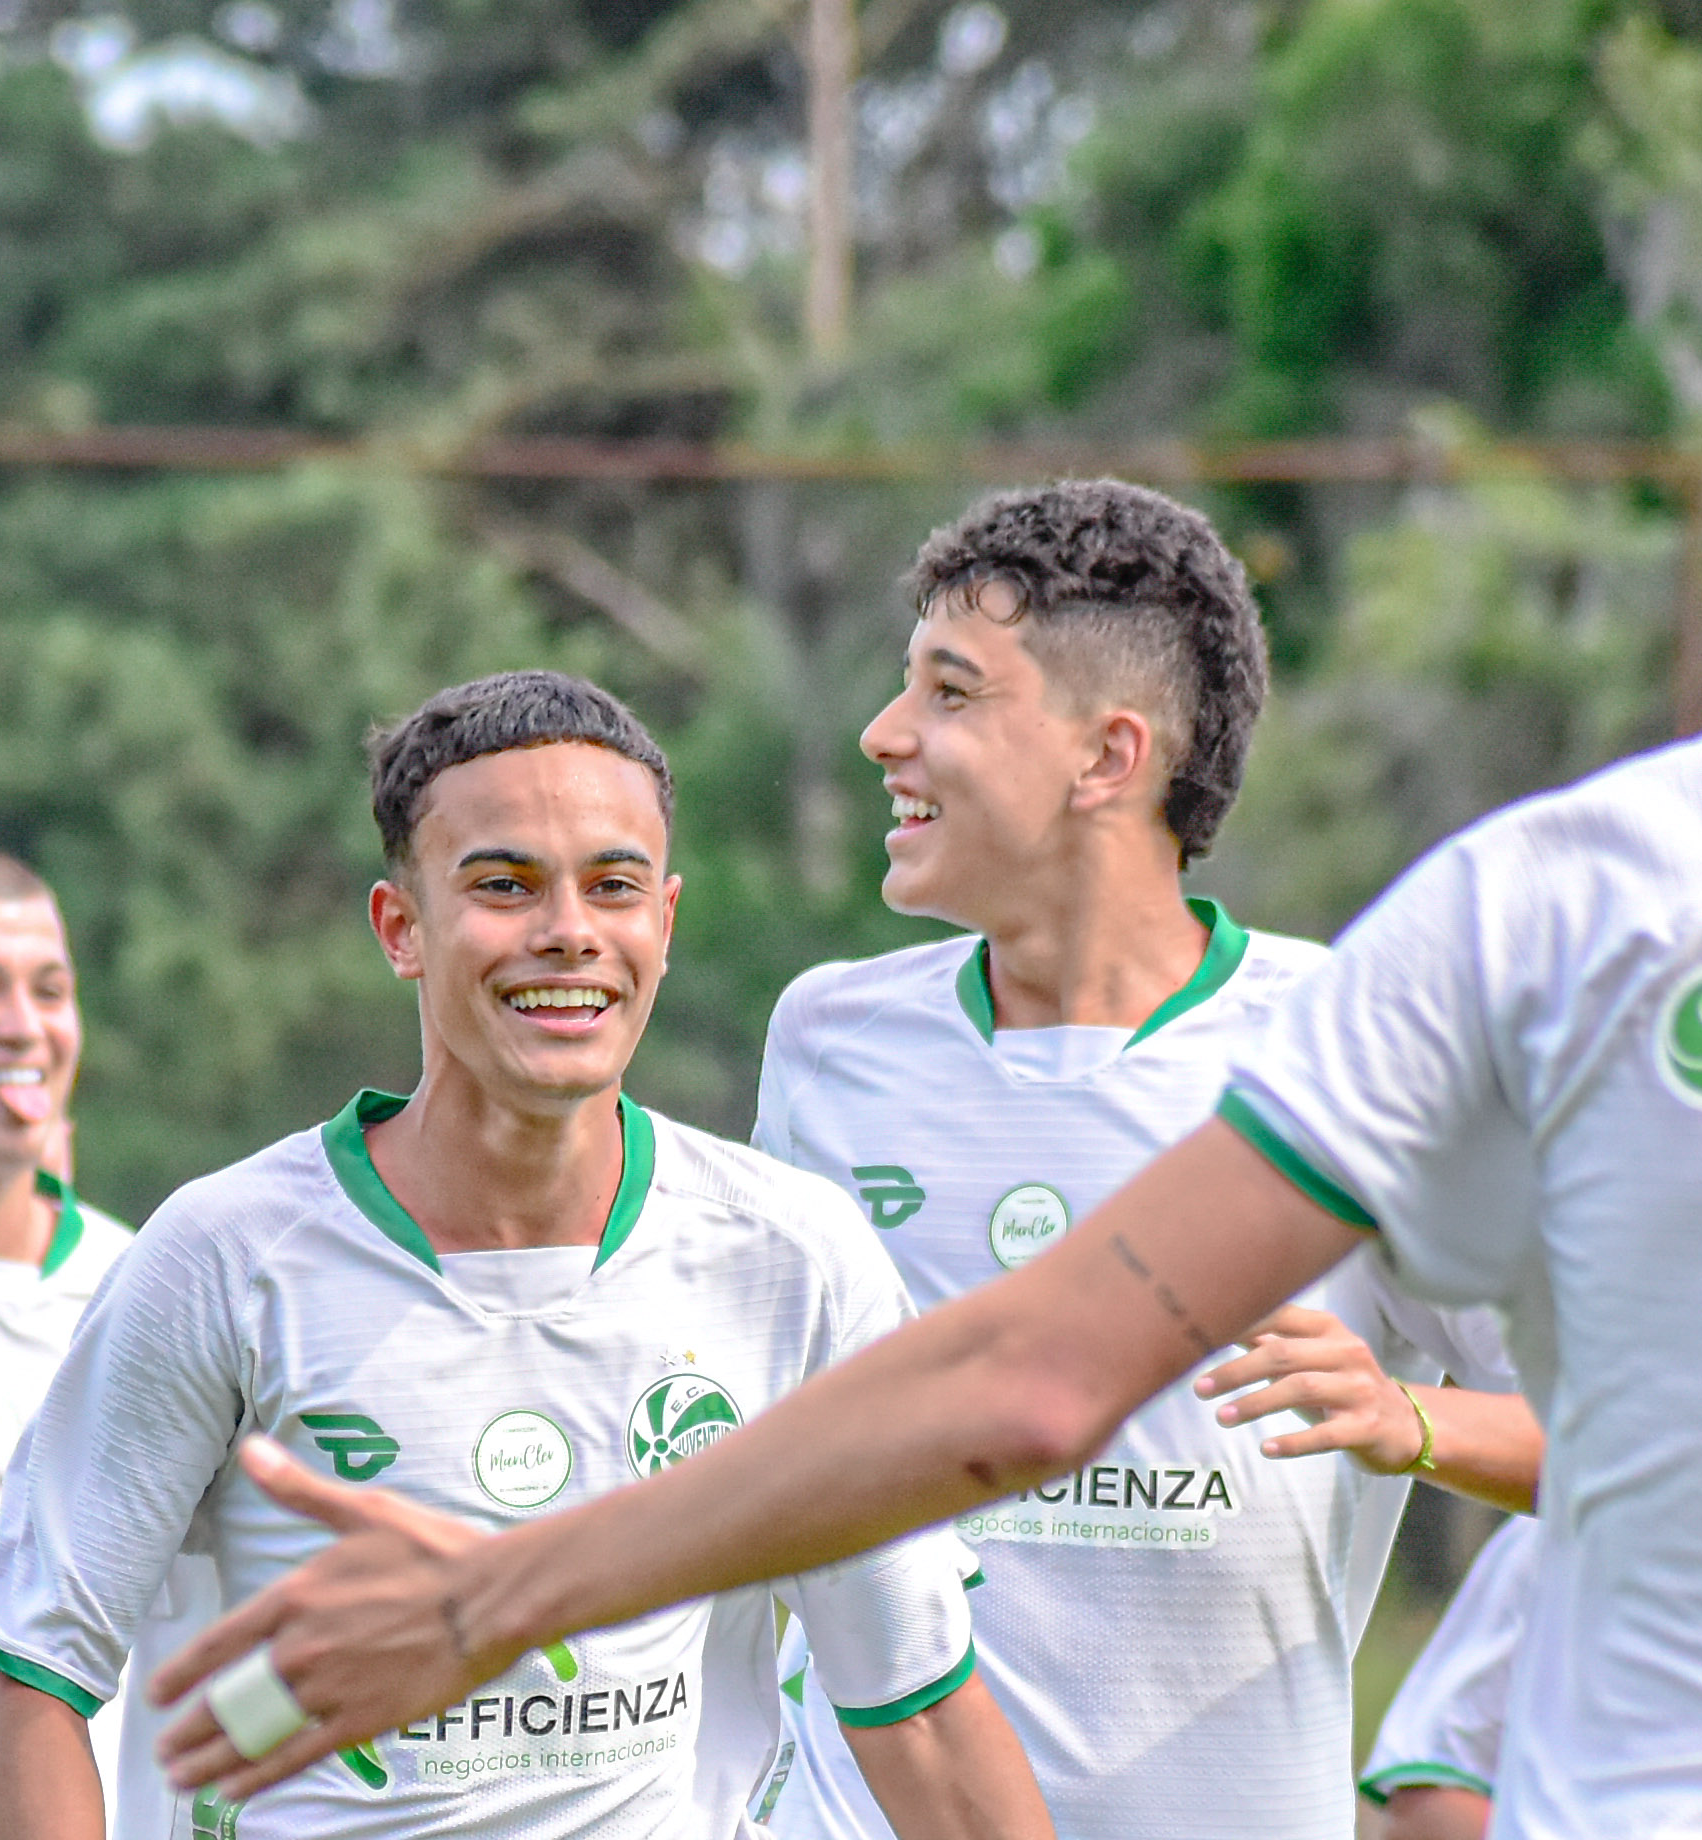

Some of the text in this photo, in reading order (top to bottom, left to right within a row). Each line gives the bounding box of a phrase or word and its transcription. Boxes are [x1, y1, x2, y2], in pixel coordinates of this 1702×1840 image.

[1051, 1516, 1211, 1543] internacionais
[424, 1731, 678, 1780] negócios internacionais
